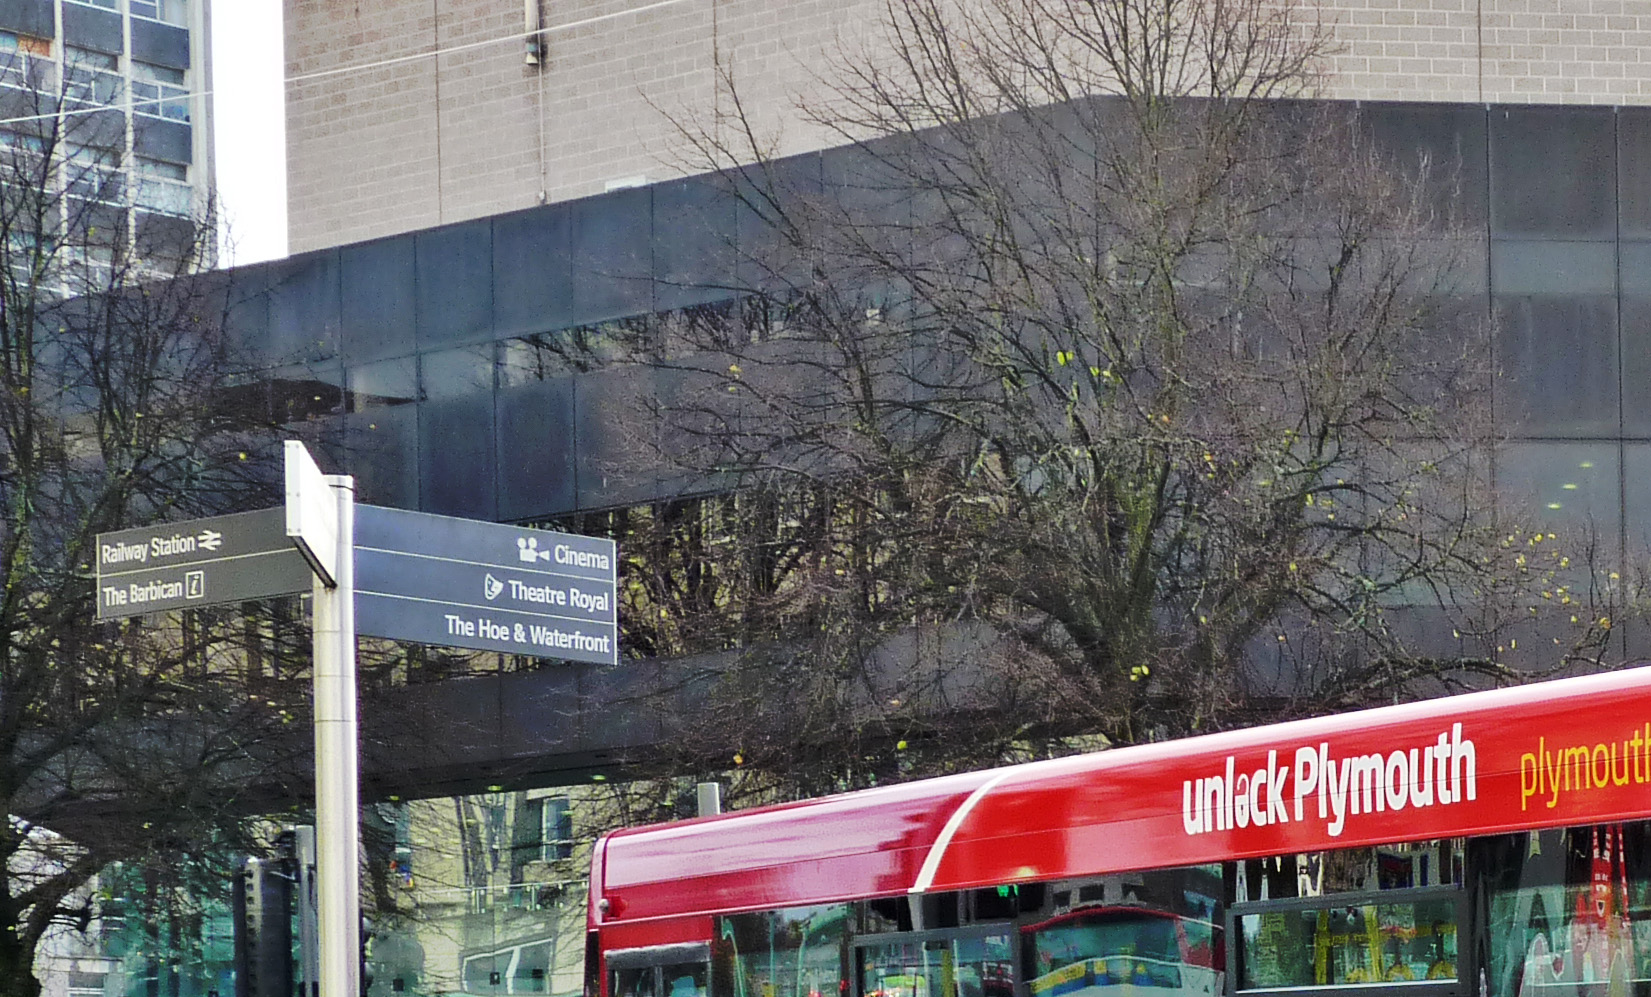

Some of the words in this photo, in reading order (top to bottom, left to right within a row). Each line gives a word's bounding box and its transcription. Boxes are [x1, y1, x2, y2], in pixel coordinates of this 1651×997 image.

[102, 541, 149, 564] Railway
[150, 535, 195, 557] Station
[554, 544, 610, 570] Cinema
[103, 586, 127, 606] The
[130, 580, 182, 603] Barbican
[508, 580, 566, 606] Theatre
[570, 588, 609, 613] Royal
[445, 615, 475, 637] The
[478, 618, 510, 641] Hoe
[514, 623, 527, 643] &
[530, 625, 610, 653] Waterfront
[1183, 750, 1289, 835] unlock
[1294, 722, 1477, 836] Plymouth
